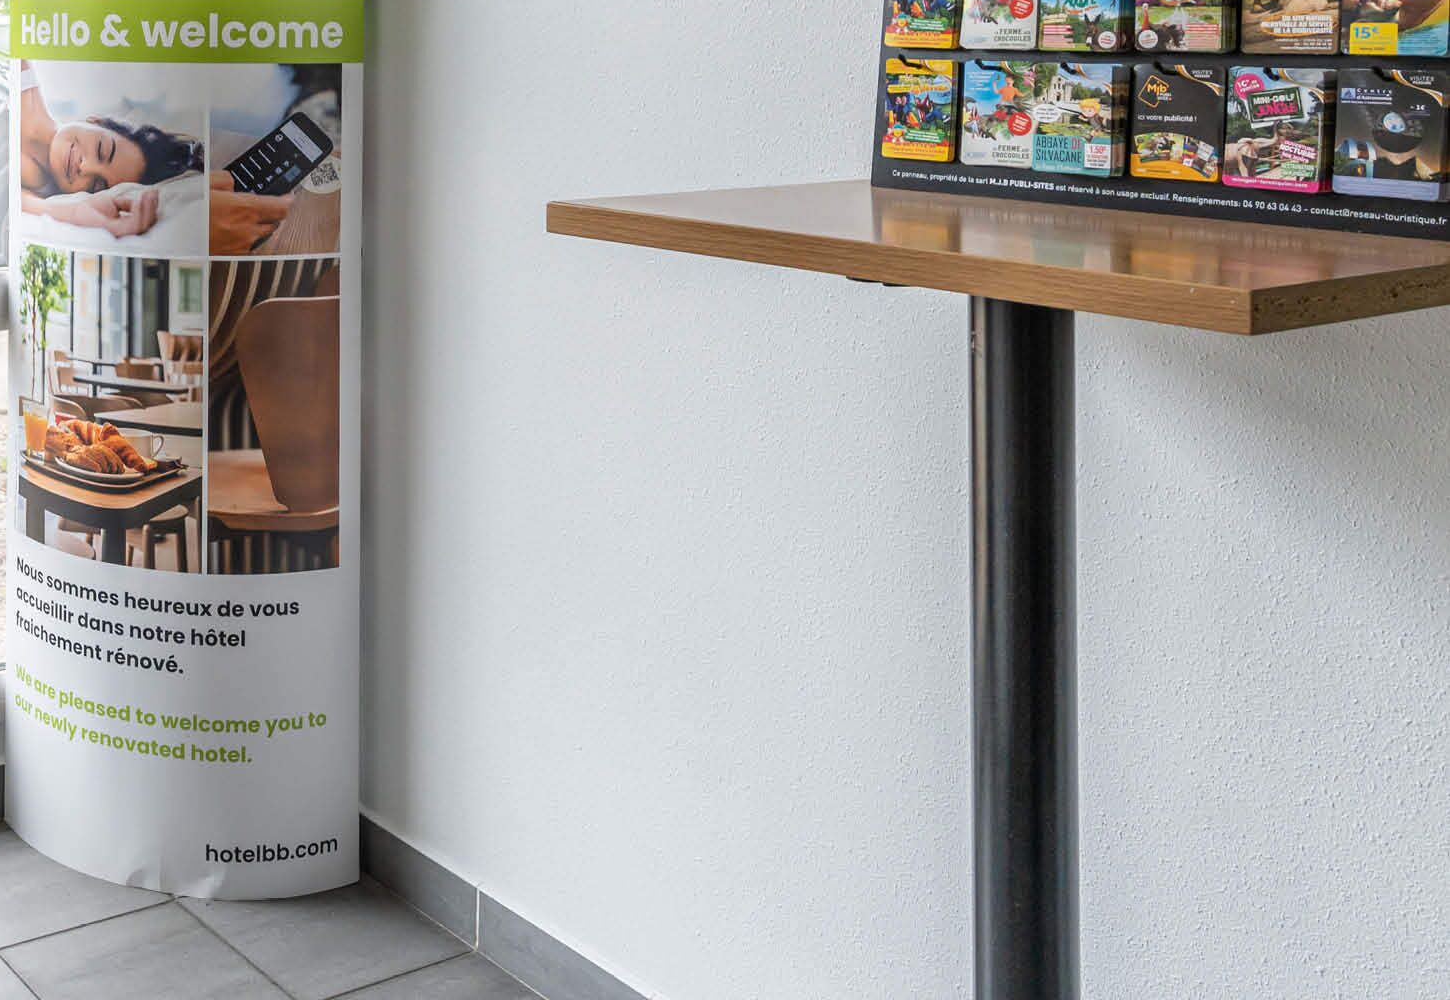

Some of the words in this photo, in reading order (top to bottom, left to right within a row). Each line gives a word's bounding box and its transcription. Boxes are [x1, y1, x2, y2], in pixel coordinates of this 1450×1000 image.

[21, 11, 91, 48] Hello
[100, 13, 131, 48] &
[141, 12, 344, 50] welcome
[1353, 25, 1380, 40] 15€
[1252, 93, 1295, 105] MINI-GOLF
[1163, 114, 1194, 123] publicité
[997, 144, 1021, 153] FERME
[1035, 136, 1069, 148] ABBAYE
[1035, 149, 1082, 164] SILVACANE
[892, 169, 901, 177] Ce
[901, 171, 929, 180] panneau,
[929, 174, 958, 184] propriété
[958, 175, 967, 183] de
[968, 176, 975, 184] la
[975, 177, 989, 185] sarl
[1009, 179, 1055, 190] PUBLI-SITES
[1055, 184, 1067, 192] est
[1067, 185, 1094, 195] réservé
[1095, 187, 1101, 195] à
[1116, 190, 1139, 199] usage
[1140, 191, 1171, 201] exclusif.
[1243, 199, 1254, 209] 04
[1254, 201, 1266, 210] 90
[1266, 202, 1278, 211] 63
[1278, 203, 1290, 212] 04
[1290, 204, 1303, 213] 43
[1310, 207, 1447, 226] contact@reseau-touristique.fr
[16, 556, 45, 585] Nous
[46, 574, 120, 607] sommes
[123, 590, 213, 618] heureux
[216, 598, 245, 618] de
[249, 600, 301, 618] vous
[16, 585, 75, 625] accueillir
[77, 609, 125, 637] dans
[129, 622, 187, 646] notre
[190, 627, 247, 648] hôtel
[15, 609, 103, 662] fraichement
[106, 647, 185, 675] rénové.
[14, 662, 32, 687] We
[33, 677, 57, 700] are
[58, 687, 131, 723] pleased
[135, 706, 157, 727] to
[160, 711, 261, 734] welcome
[264, 712, 304, 739] you
[307, 710, 328, 729] to
[14, 693, 34, 715] our
[34, 705, 78, 741] newly
[80, 725, 187, 760] renovated
[190, 743, 253, 764] hotel.
[205, 835, 339, 865] hotelbb.com
